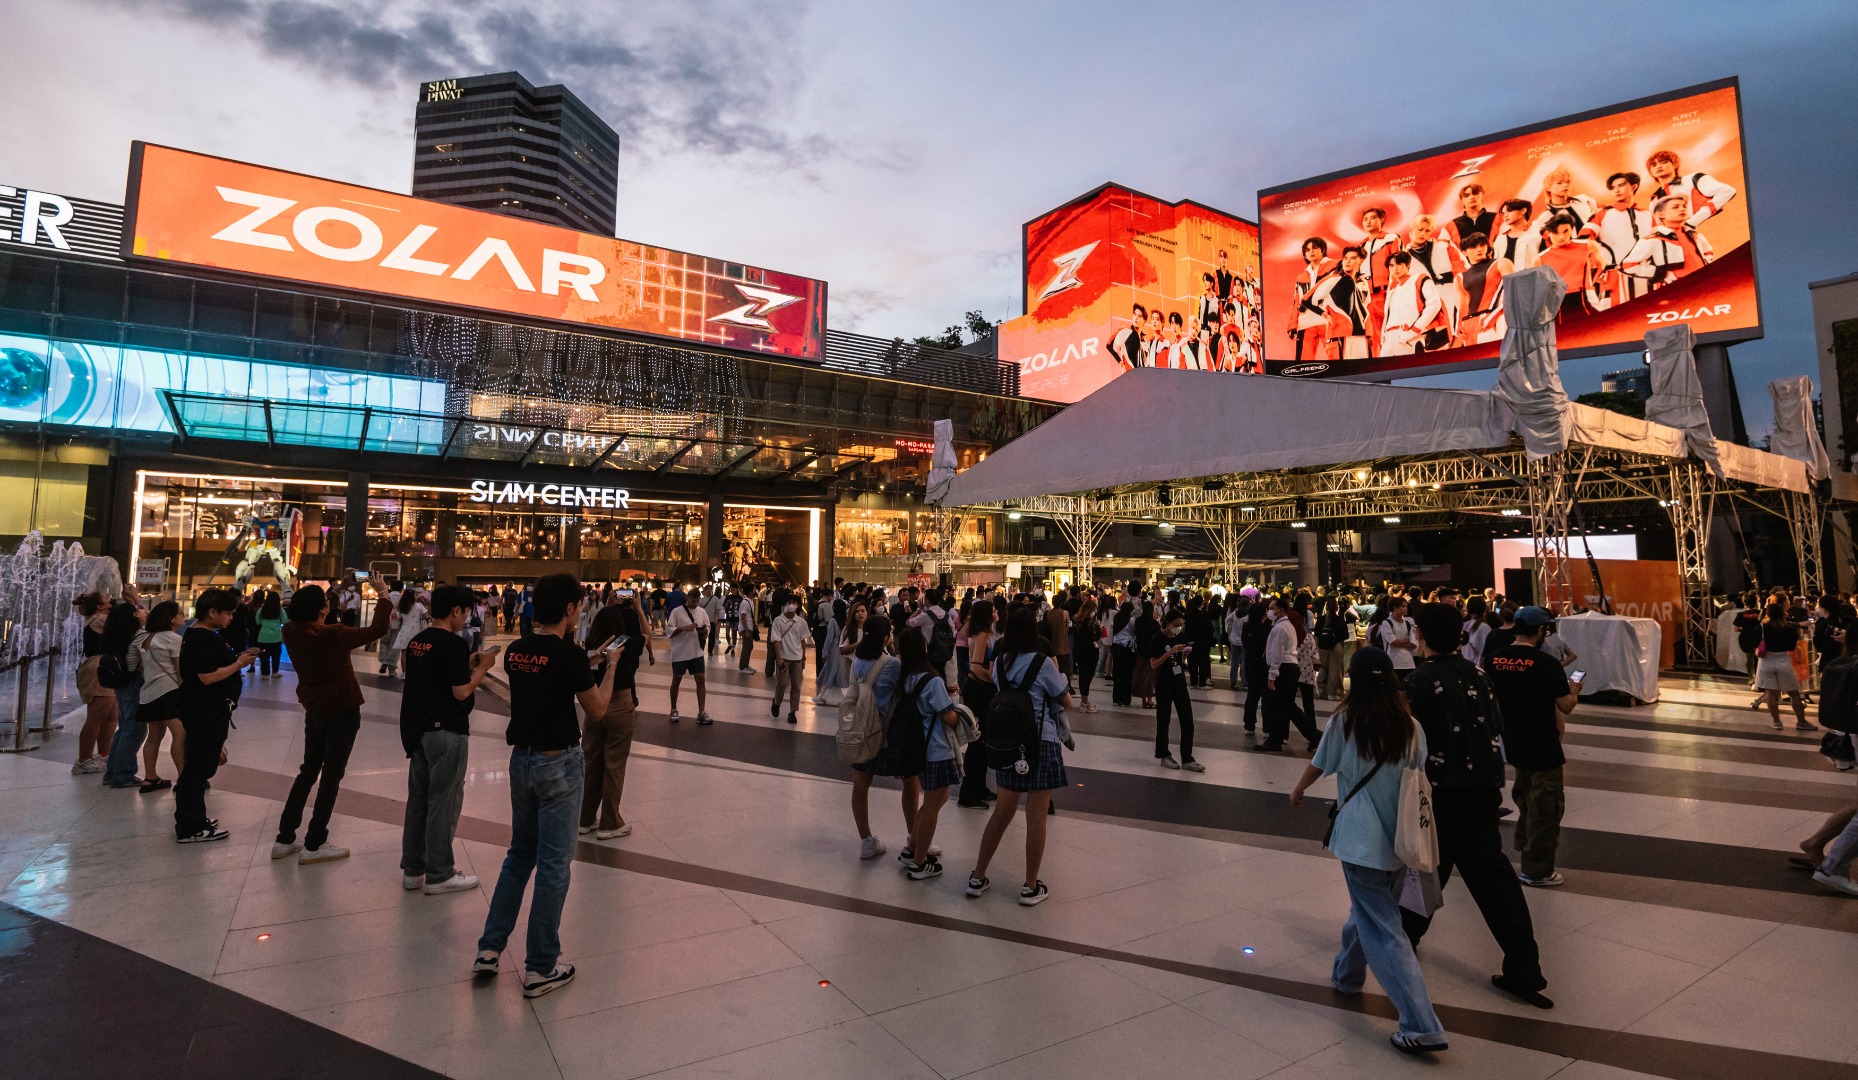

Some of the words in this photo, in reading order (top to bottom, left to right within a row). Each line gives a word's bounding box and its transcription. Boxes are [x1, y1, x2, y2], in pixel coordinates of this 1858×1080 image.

[428, 80, 457, 92] SIAM
[427, 88, 465, 102] PIWAT
[1672, 111, 1699, 121] KRIT
[1672, 118, 1700, 128] MAN
[1607, 127, 1627, 136] TAE
[1528, 141, 1564, 154] FOCUS
[1390, 175, 1416, 185] PANN
[1390, 181, 1416, 191] EURO
[1354, 190, 1377, 199] PAUL
[1283, 197, 1319, 209] DEENAN
[1284, 205, 1306, 215] BLUE
[210, 185, 606, 302] ZOLAR
[1646, 303, 1732, 324] ZOLAR
[1018, 337, 1099, 376] ZOLAR
[470, 480, 535, 505] SIAM
[541, 484, 630, 509] CENTER
[1615, 601, 1673, 621] ZOLAR
[509, 652, 549, 666] ZOLAR
[1492, 657, 1534, 667] ZOLAR
[510, 662, 542, 673] CREW
[1495, 664, 1527, 672] CREW
